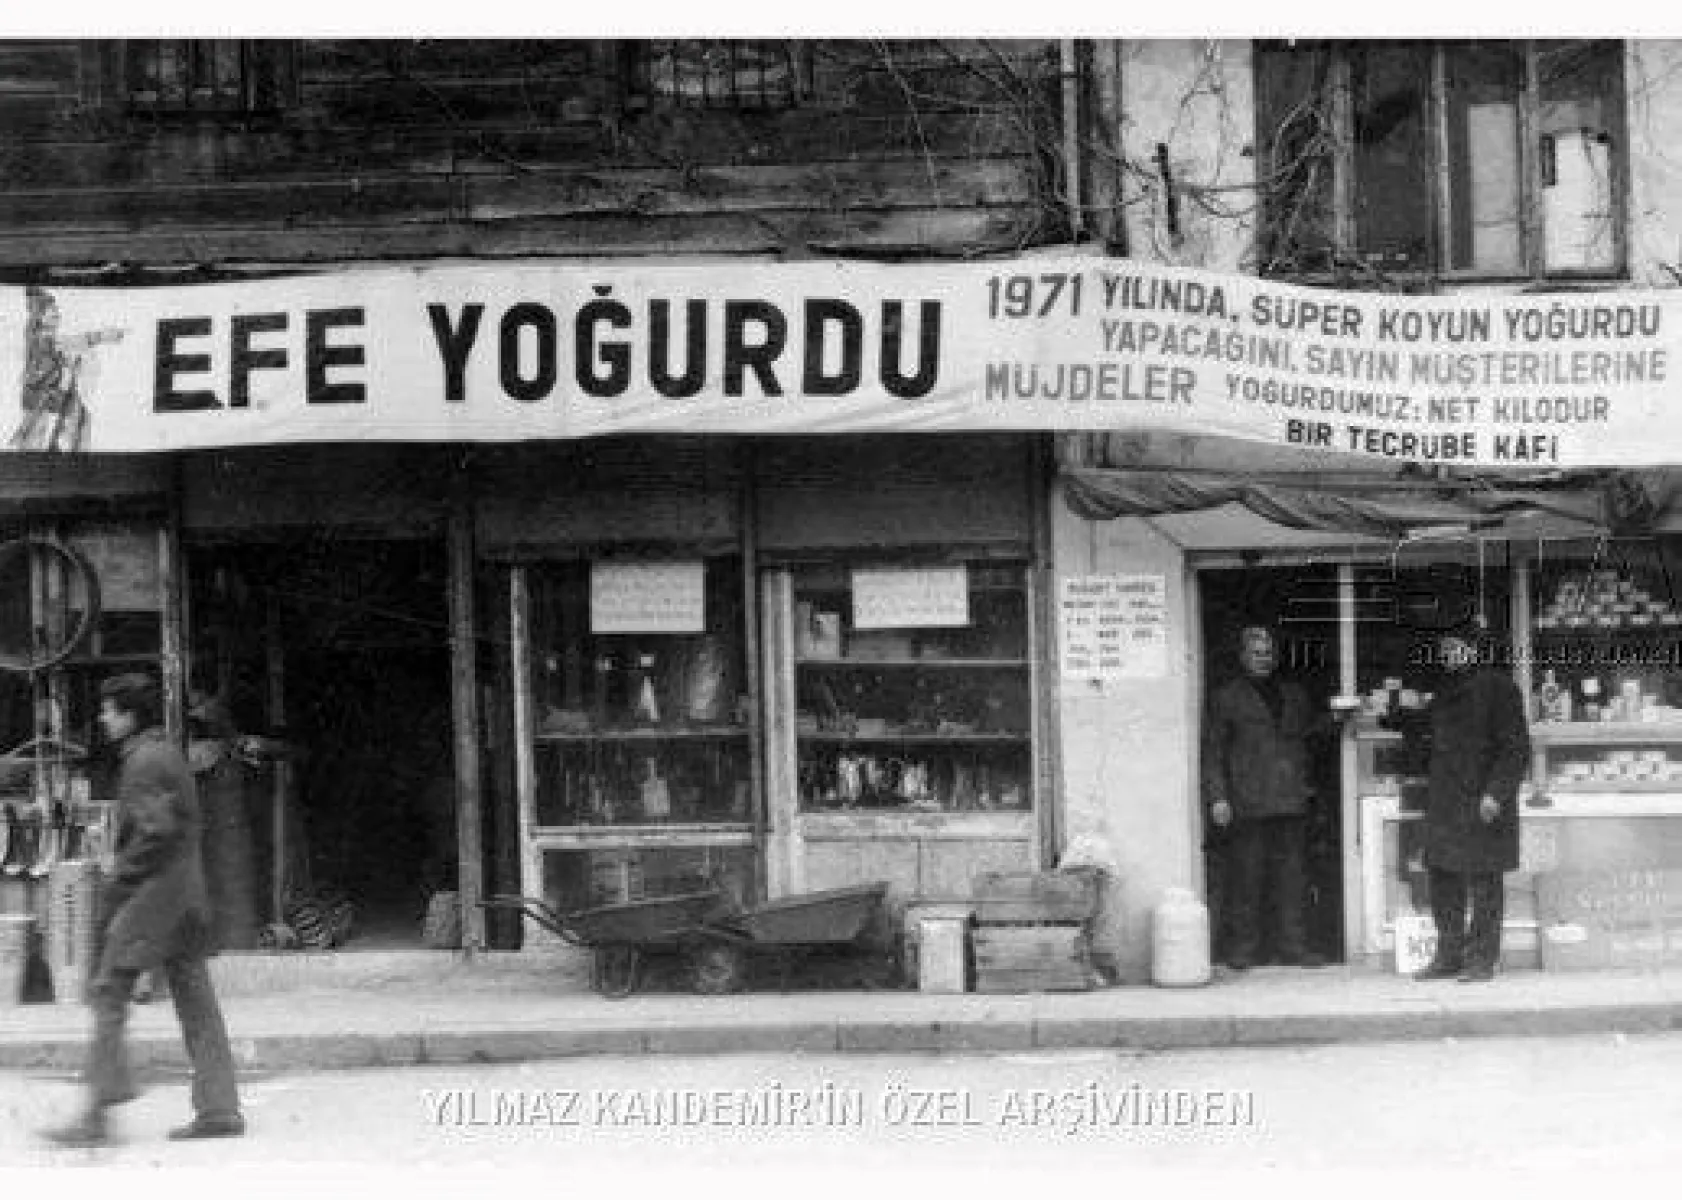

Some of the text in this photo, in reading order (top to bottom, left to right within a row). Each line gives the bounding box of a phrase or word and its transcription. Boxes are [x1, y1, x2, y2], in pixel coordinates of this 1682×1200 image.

[986, 273, 1083, 319] 1971
[1378, 308, 1491, 342] KOYUN
[1503, 302, 1661, 341] YOĞURDU
[152, 284, 942, 412] EFE YOĞURDU
[1427, 396, 1481, 423] NET
